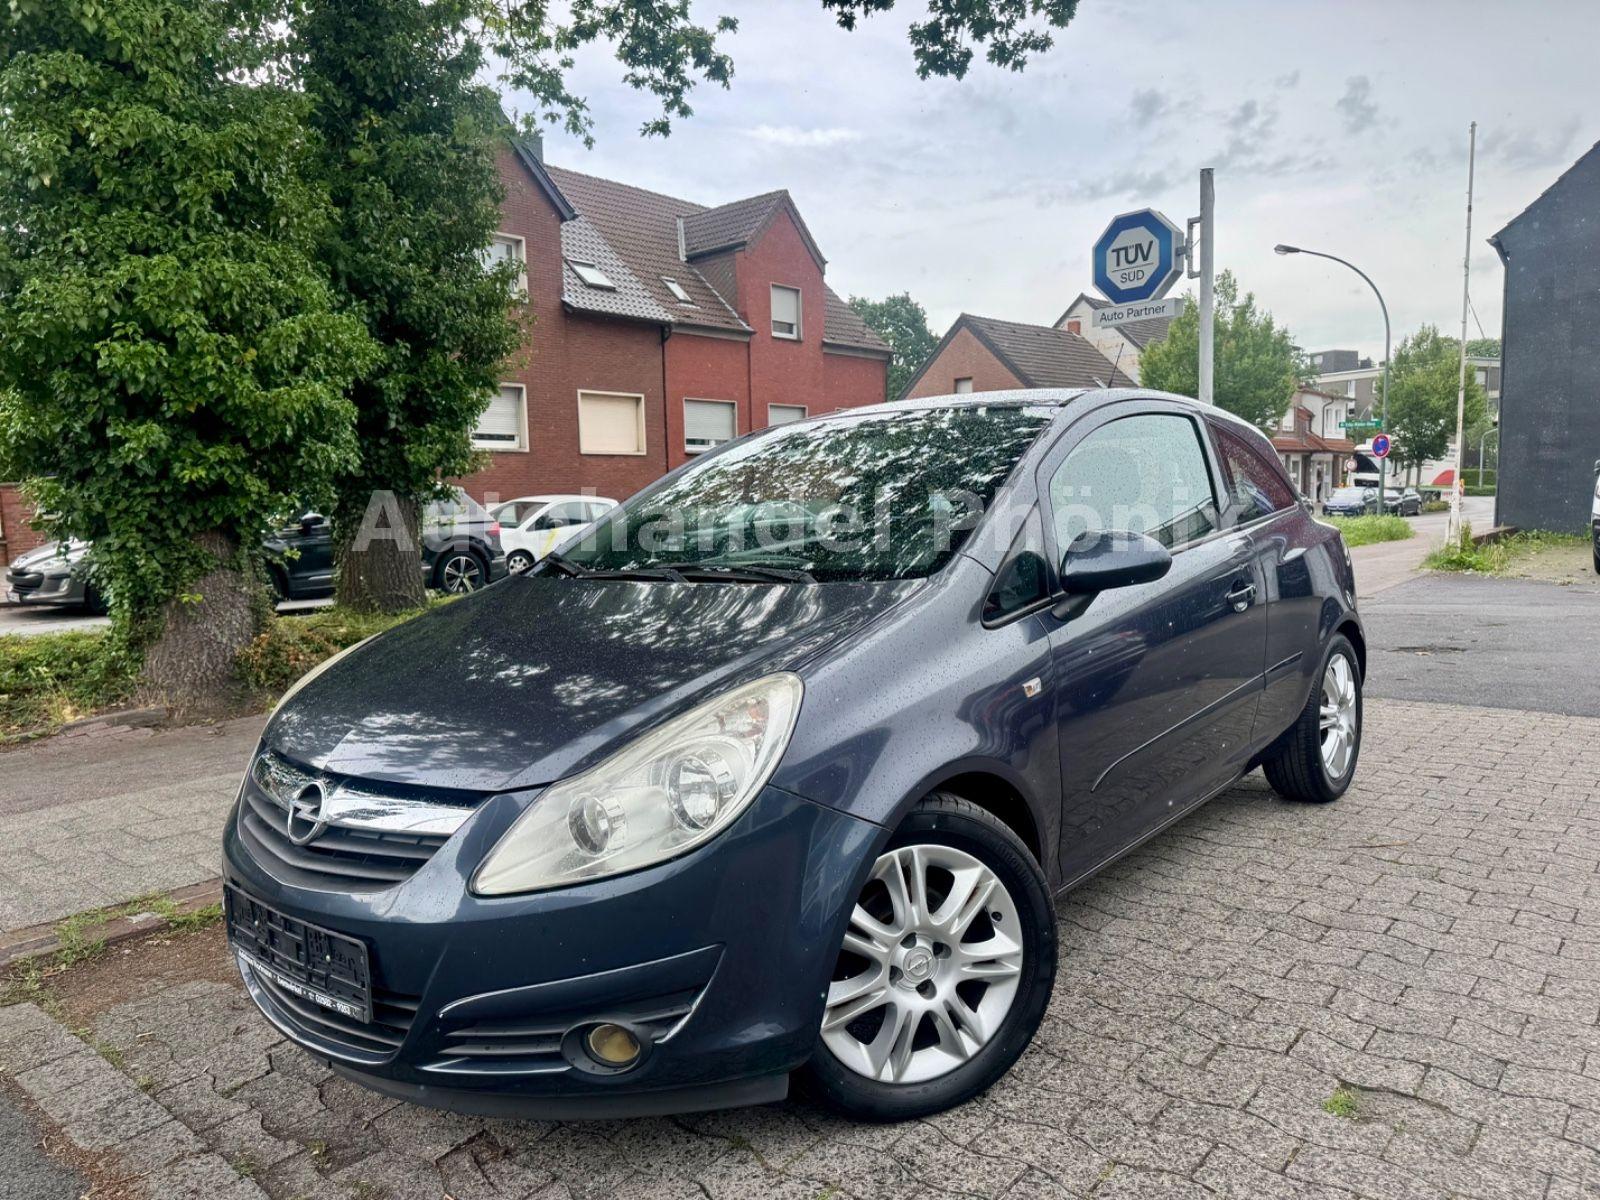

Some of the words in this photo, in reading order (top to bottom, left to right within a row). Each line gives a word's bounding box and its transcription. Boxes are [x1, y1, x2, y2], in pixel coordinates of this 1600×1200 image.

[1111, 240, 1153, 267] TÜV
[1120, 269, 1145, 284] SÜD
[1099, 311, 1124, 323] Auto
[1126, 304, 1166, 318] Partner
